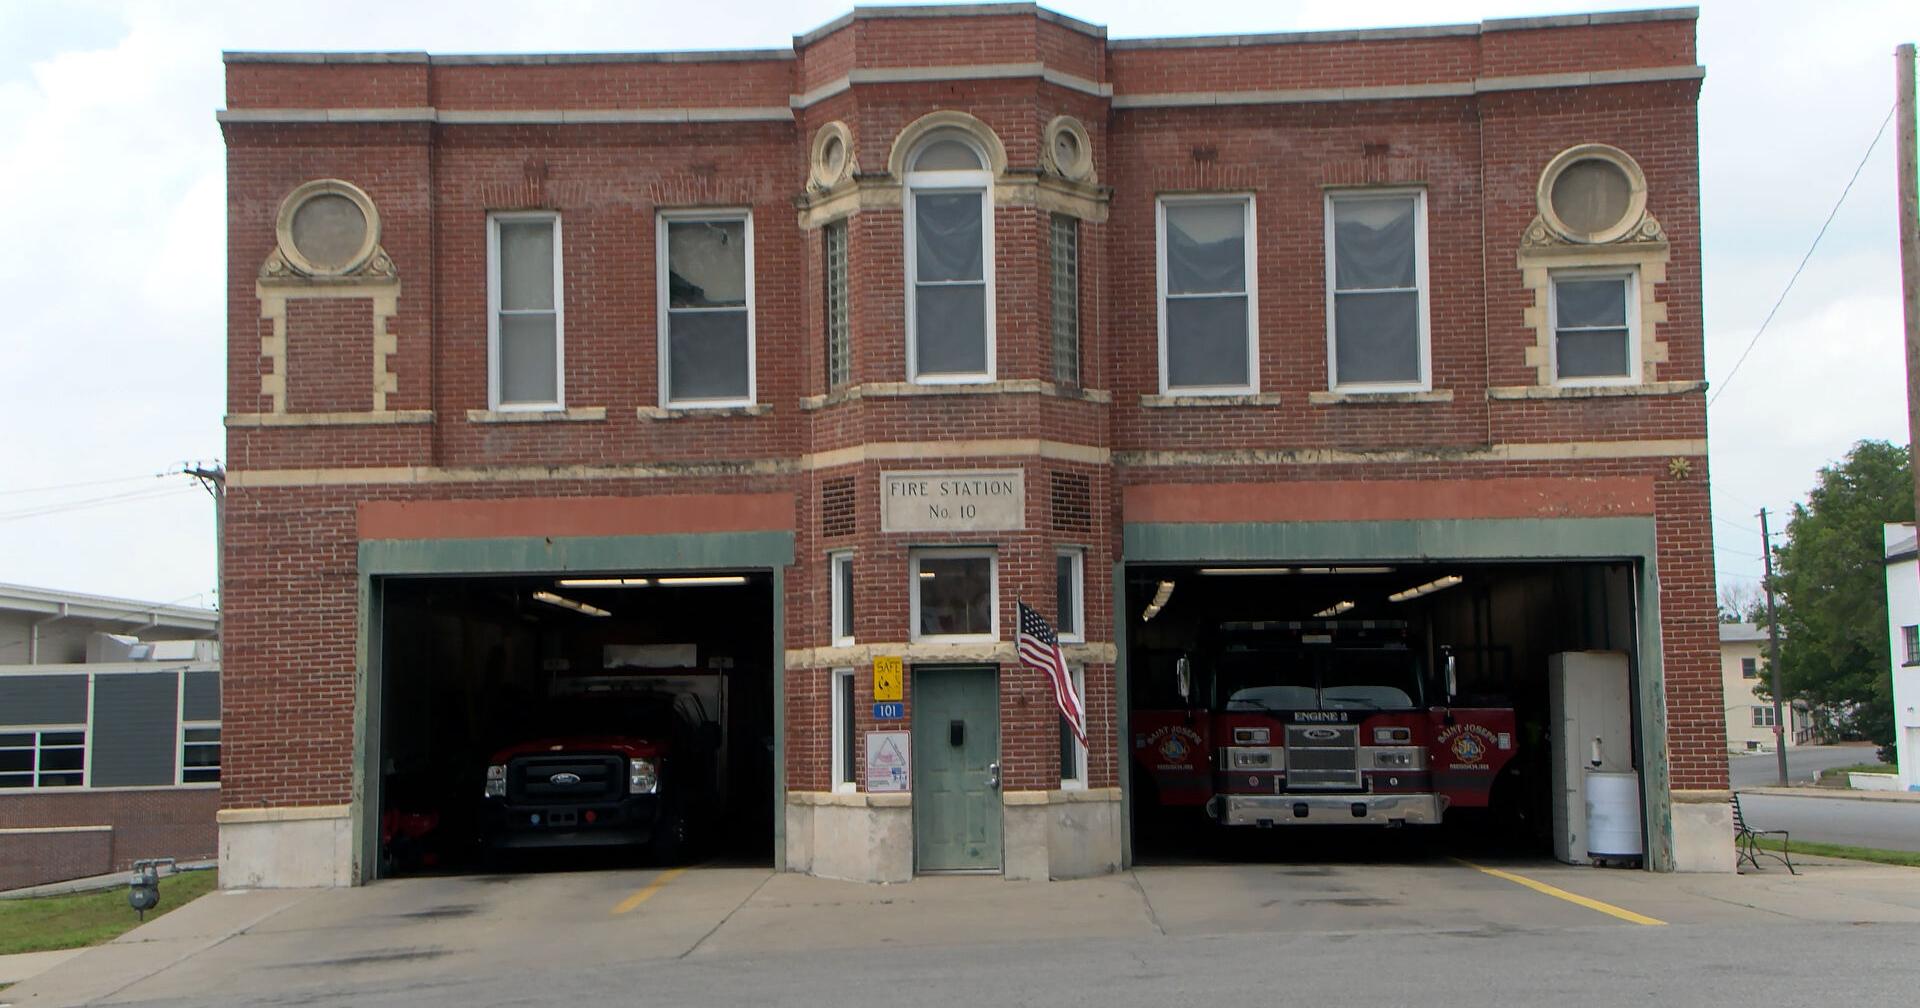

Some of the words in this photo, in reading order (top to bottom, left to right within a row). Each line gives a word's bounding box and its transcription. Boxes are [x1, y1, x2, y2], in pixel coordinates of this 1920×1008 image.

[890, 481, 929, 497] FIRE
[940, 480, 1013, 497] STATION
[960, 504, 976, 519] 10
[877, 661, 901, 673] SAFE
[880, 705, 896, 717] 101
[1294, 711, 1338, 721] ENGINE
[1147, 725, 1170, 745] SAINT
[1437, 724, 1462, 743] SAINT
[1463, 723, 1498, 744] JOSEPH
